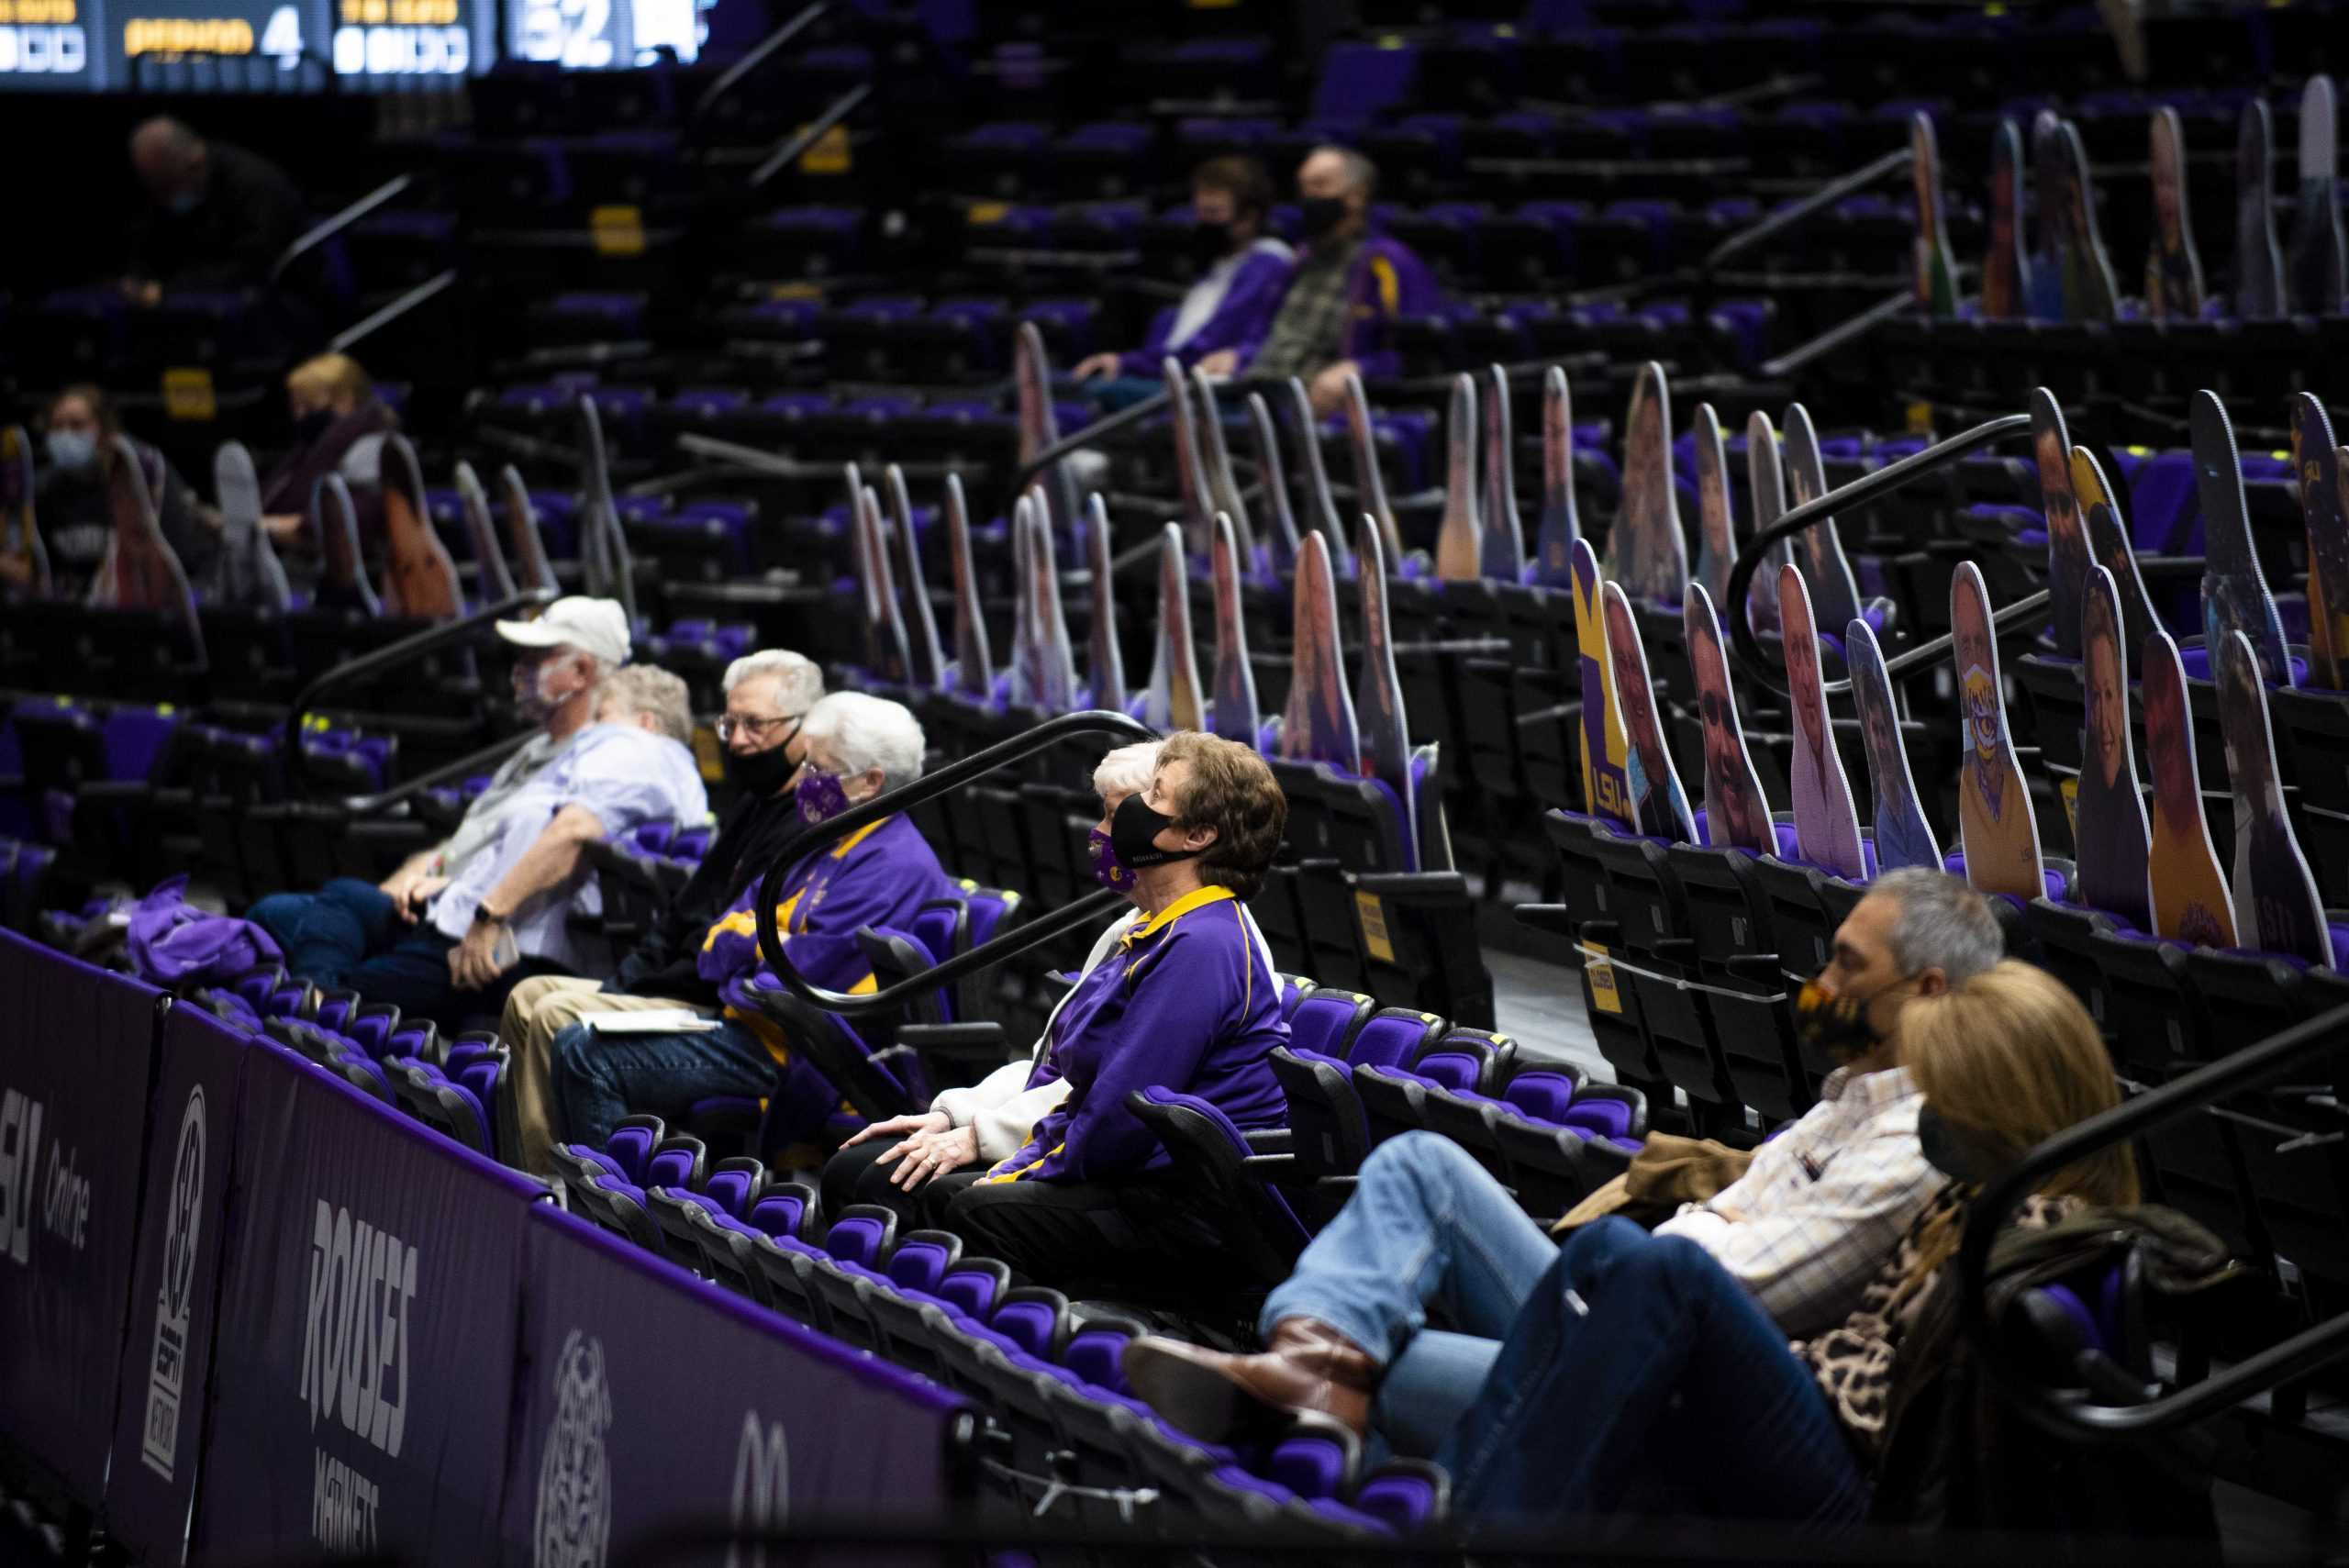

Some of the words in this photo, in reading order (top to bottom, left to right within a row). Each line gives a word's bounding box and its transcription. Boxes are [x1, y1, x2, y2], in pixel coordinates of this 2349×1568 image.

[261, 5, 304, 72] 4
[1593, 767, 1622, 817] LSU
[44, 1139, 90, 1251] Online
[168, 1119, 199, 1318] SEC
[300, 1198, 417, 1459] ROUSES
[312, 1446, 379, 1558] MARKETS
